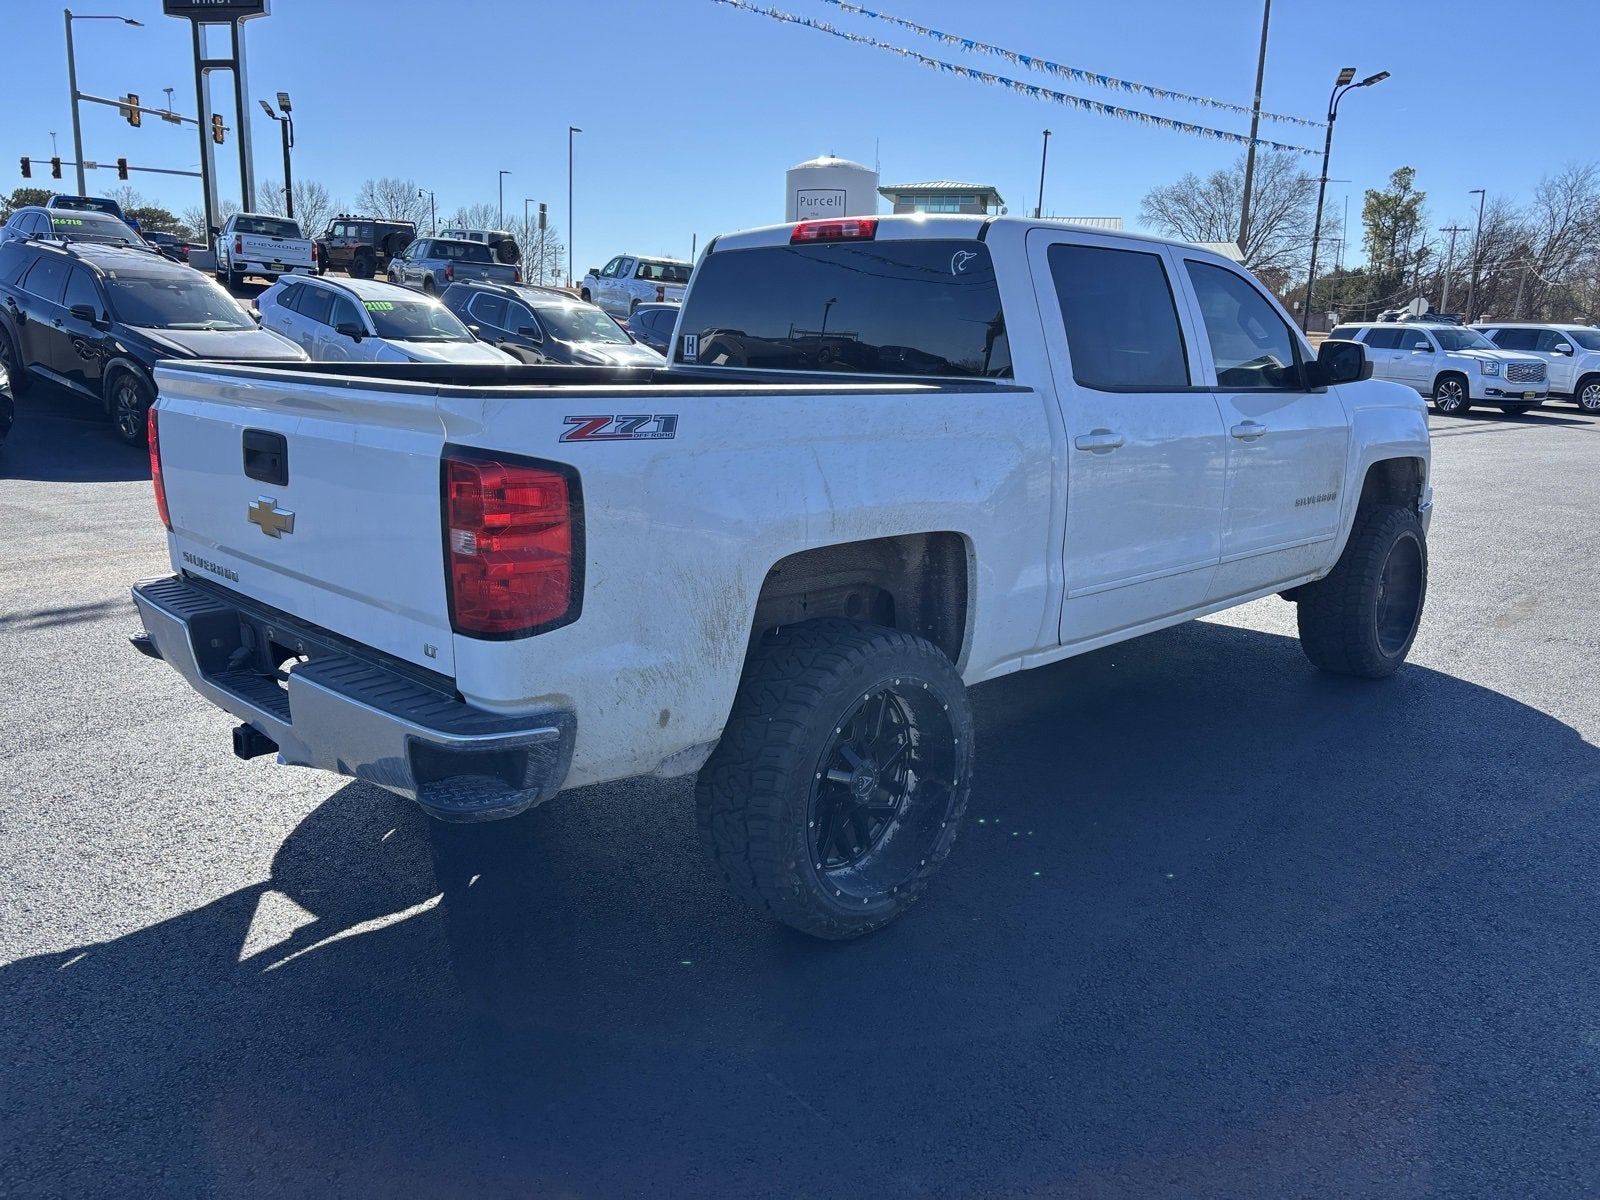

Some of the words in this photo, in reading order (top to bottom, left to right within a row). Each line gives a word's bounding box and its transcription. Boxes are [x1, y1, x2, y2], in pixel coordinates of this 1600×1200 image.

[800, 195, 842, 206] Purcell
[246, 241, 308, 251] CHEVROLET
[559, 414, 679, 443] Z71
[1295, 491, 1337, 507] SILVERADO
[182, 551, 240, 583] SILVERADO
[423, 643, 439, 659] LT
